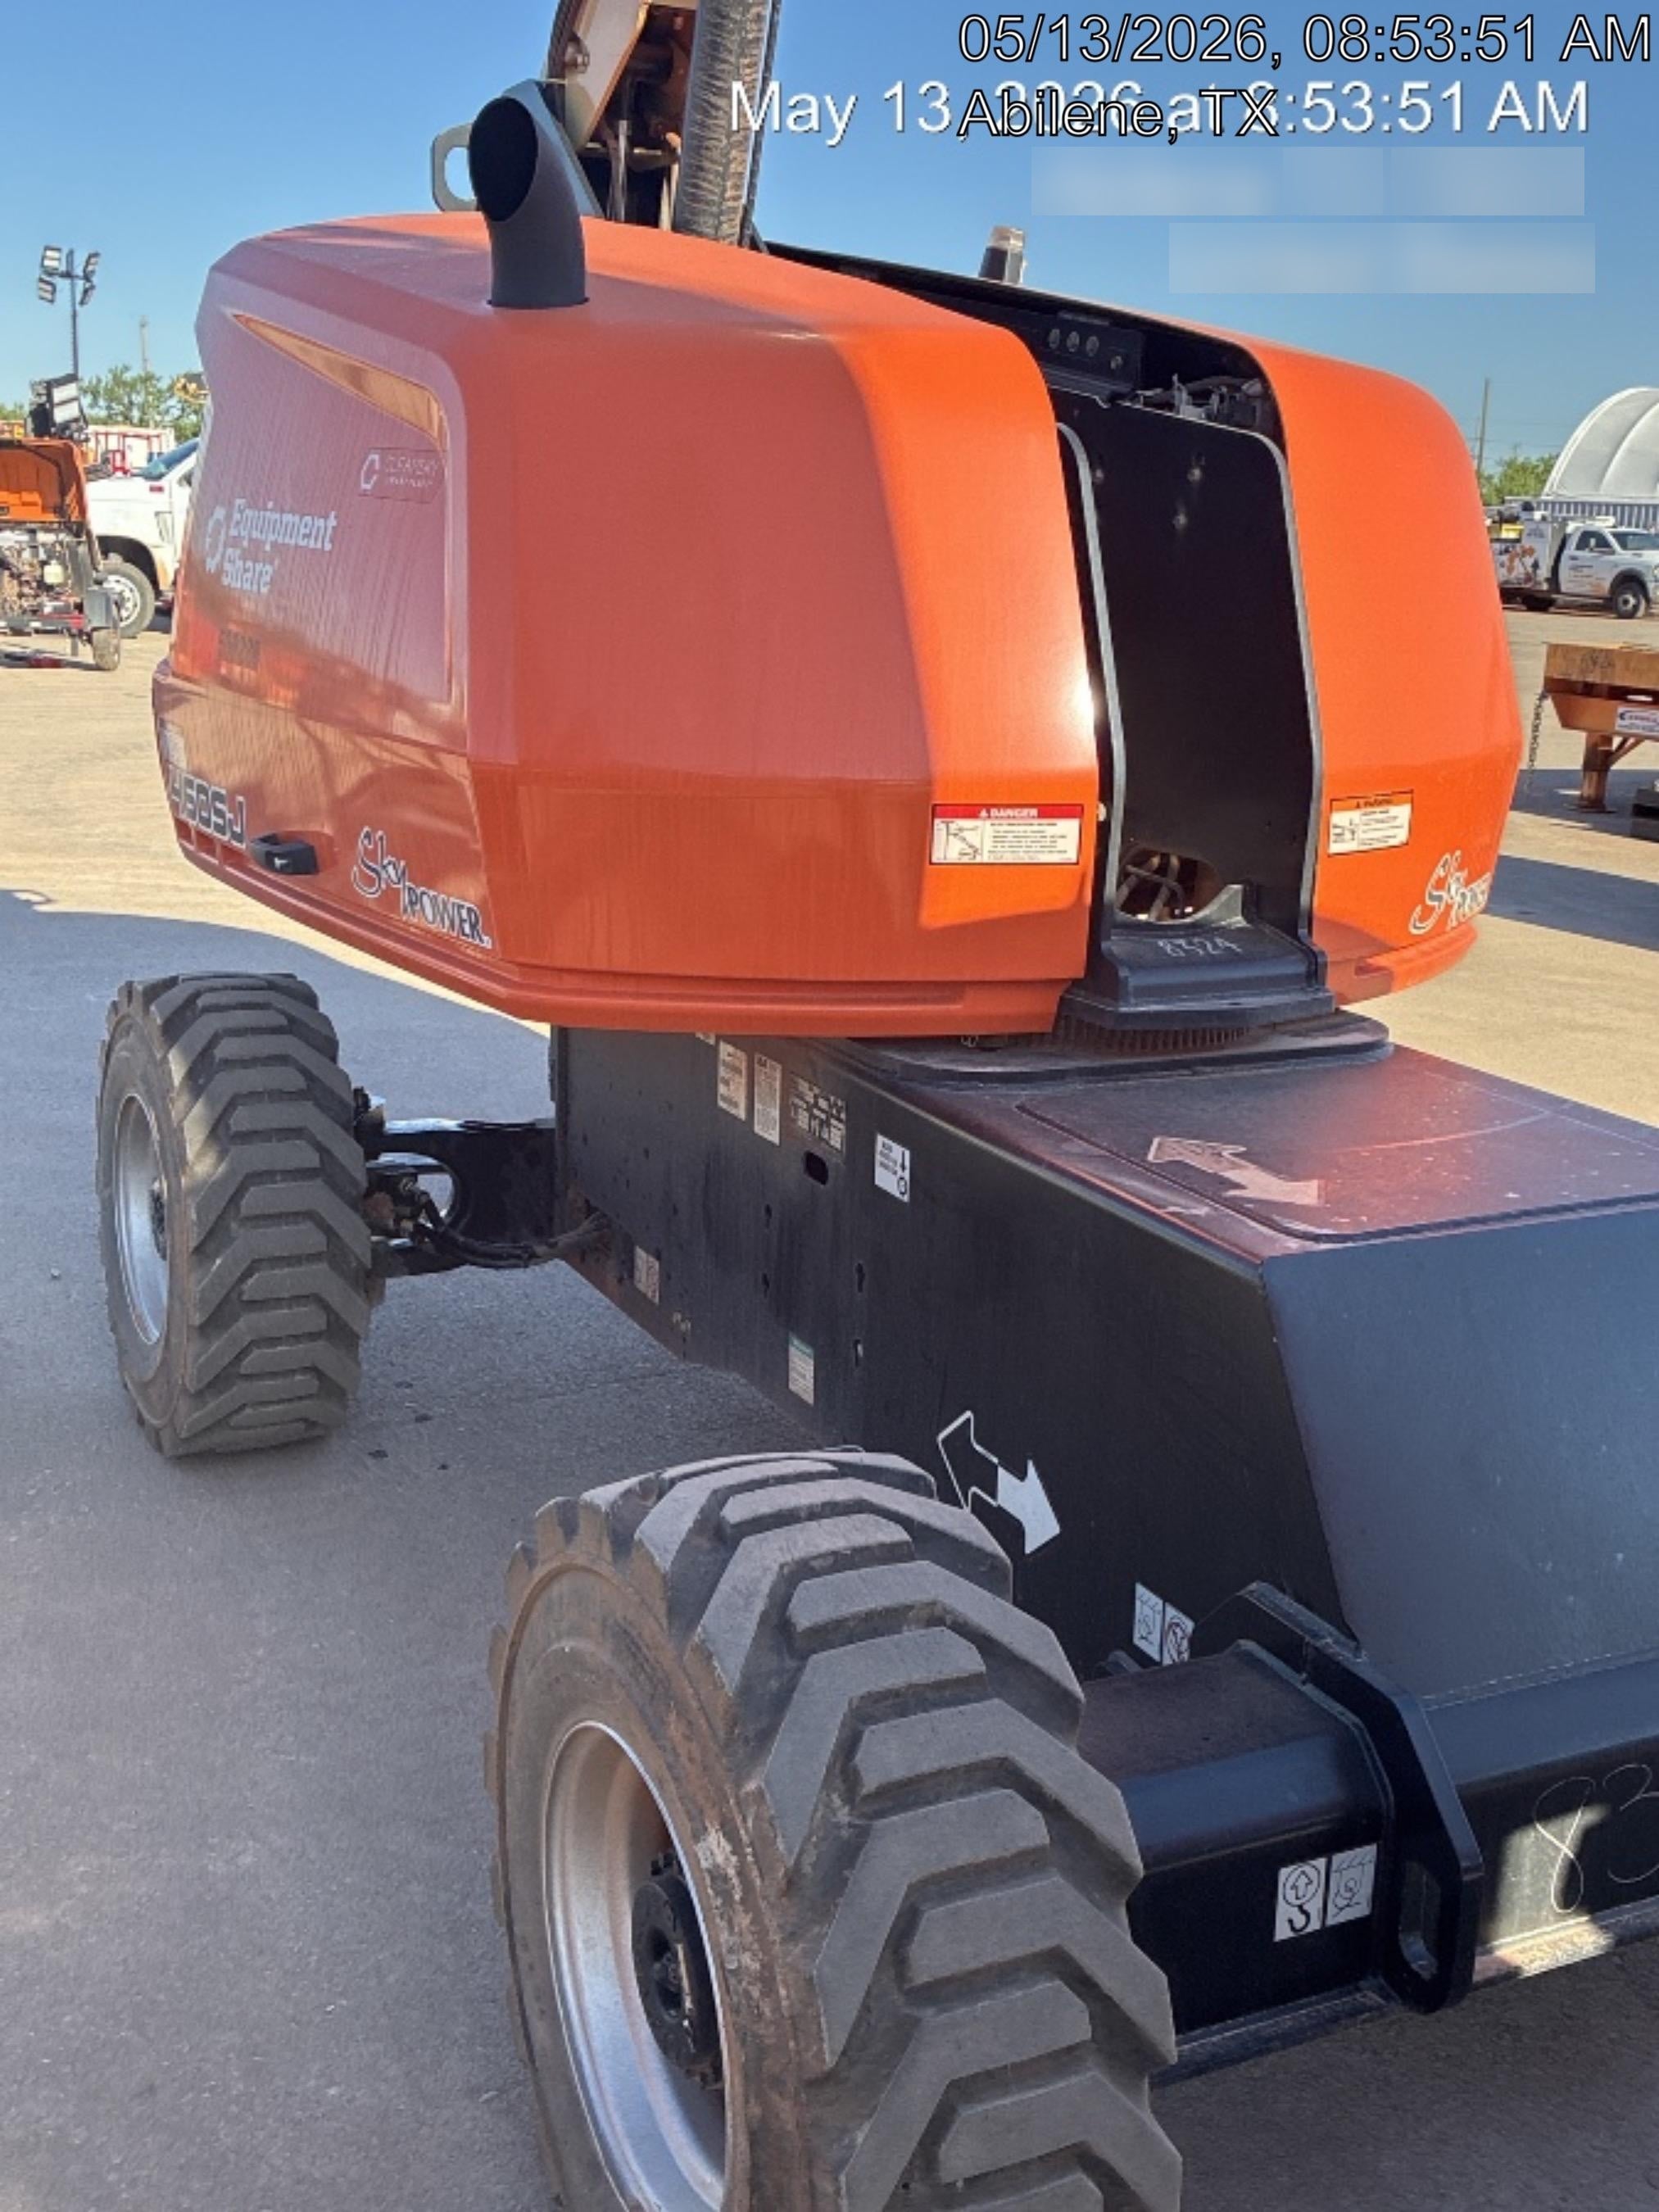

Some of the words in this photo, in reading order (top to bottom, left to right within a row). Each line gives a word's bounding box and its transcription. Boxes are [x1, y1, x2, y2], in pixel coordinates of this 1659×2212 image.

[229, 498, 338, 551] Equipment
[221, 546, 274, 593] Share
[990, 807, 1039, 818] DANGER
[351, 825, 408, 922] Sky
[402, 881, 486, 948] POWER
